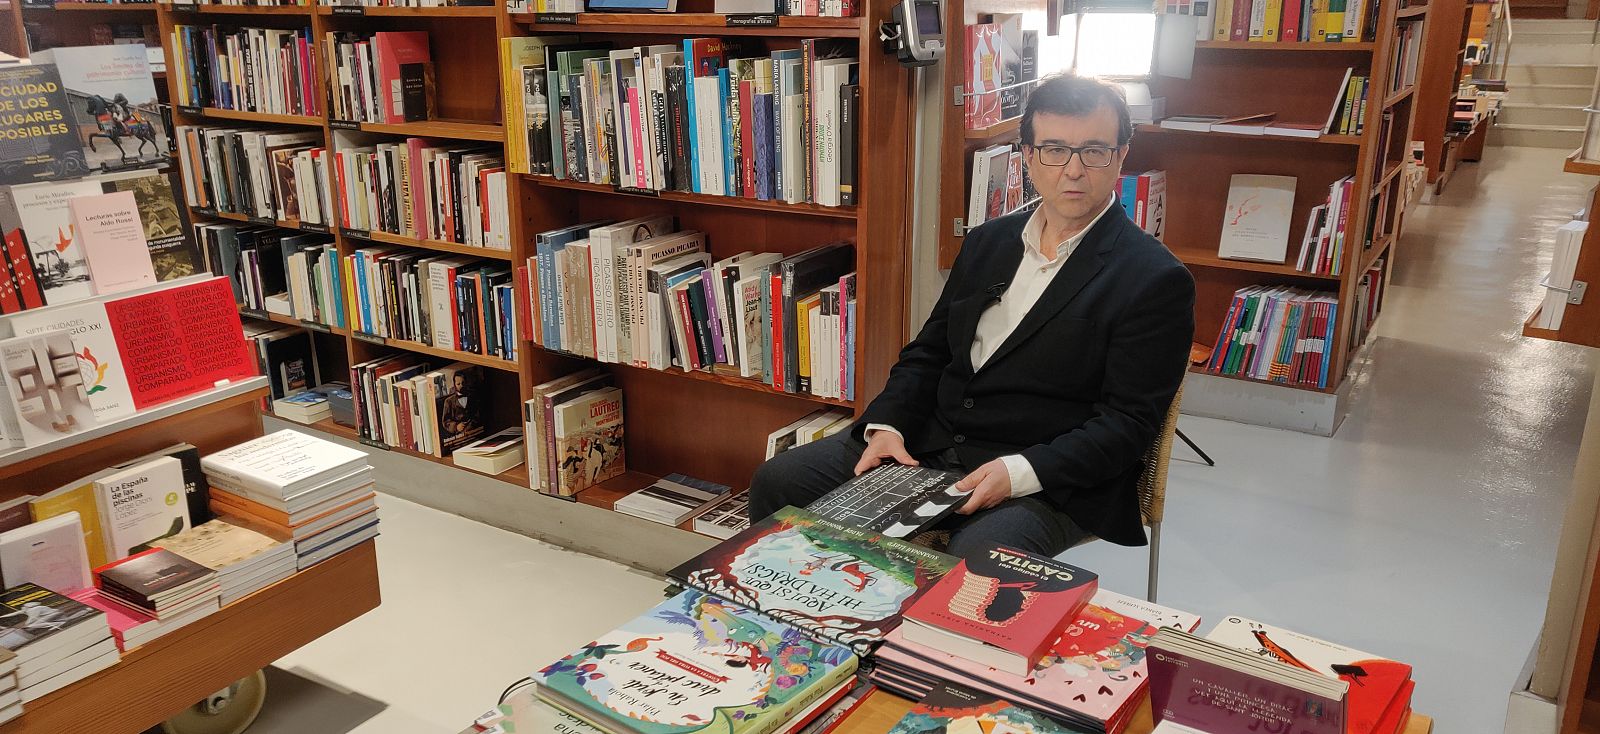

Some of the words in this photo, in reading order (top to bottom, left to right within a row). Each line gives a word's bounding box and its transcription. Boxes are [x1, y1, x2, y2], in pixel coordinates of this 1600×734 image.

[707, 43, 720, 53] David
[1, 82, 57, 97] CIUDAD
[730, 73, 738, 98] Frida
[20, 97, 49, 110] LOS
[731, 99, 740, 125] Kahlo
[0, 123, 69, 140] POSIBLES
[775, 125, 780, 134] OF
[85, 213, 113, 222] Lecturas
[114, 210, 131, 218] sobre
[651, 246, 676, 260] PICASSO
[676, 240, 700, 253] PICABIA
[593, 257, 601, 297] PICASSO
[604, 258, 612, 298] PICASSO
[173, 284, 223, 300] URBANISMO
[176, 291, 228, 309] COMPARADO
[177, 300, 226, 318] URBANISMO
[180, 308, 232, 326] COMPARADO
[596, 299, 604, 327] IBERO
[606, 300, 614, 328] IBERO
[26, 326, 43, 336] SIETE
[46, 319, 85, 331] CIUDADES
[70, 326, 87, 336] GLO
[183, 317, 230, 334] URBANISMO
[184, 325, 234, 343] COMPARADO
[187, 334, 238, 351] URBANISMO
[189, 340, 242, 359] COMPARADO
[191, 350, 237, 368] URBANISMO
[194, 358, 242, 376] COMPARADO
[590, 400, 620, 418] LAUTREC
[110, 485, 120, 493] La
[121, 476, 148, 490] España
[123, 488, 134, 496] las
[113, 492, 143, 507] piscinas
[906, 546, 939, 560] SUSANNAH
[989, 550, 1073, 581] CAPITAL
[998, 562, 1012, 571] del
[1012, 567, 1040, 578] código
[742, 577, 771, 592] QUE
[806, 583, 839, 601] HA
[789, 592, 834, 613] AQUÍ
[840, 596, 864, 610] HI
[622, 679, 668, 698] Jordi
[684, 680, 721, 697] drac
[1192, 677, 1204, 685] UN
[1270, 701, 1294, 713] DRAC
[1214, 690, 1232, 698] UNA
[608, 688, 638, 707] Rahola
[668, 692, 688, 706] En
[638, 701, 660, 716] Pilar
[1195, 689, 1210, 698] VET
[1238, 702, 1248, 710] LA
[1252, 707, 1292, 724] LLEGENDA
[1226, 704, 1245, 715] SANT
